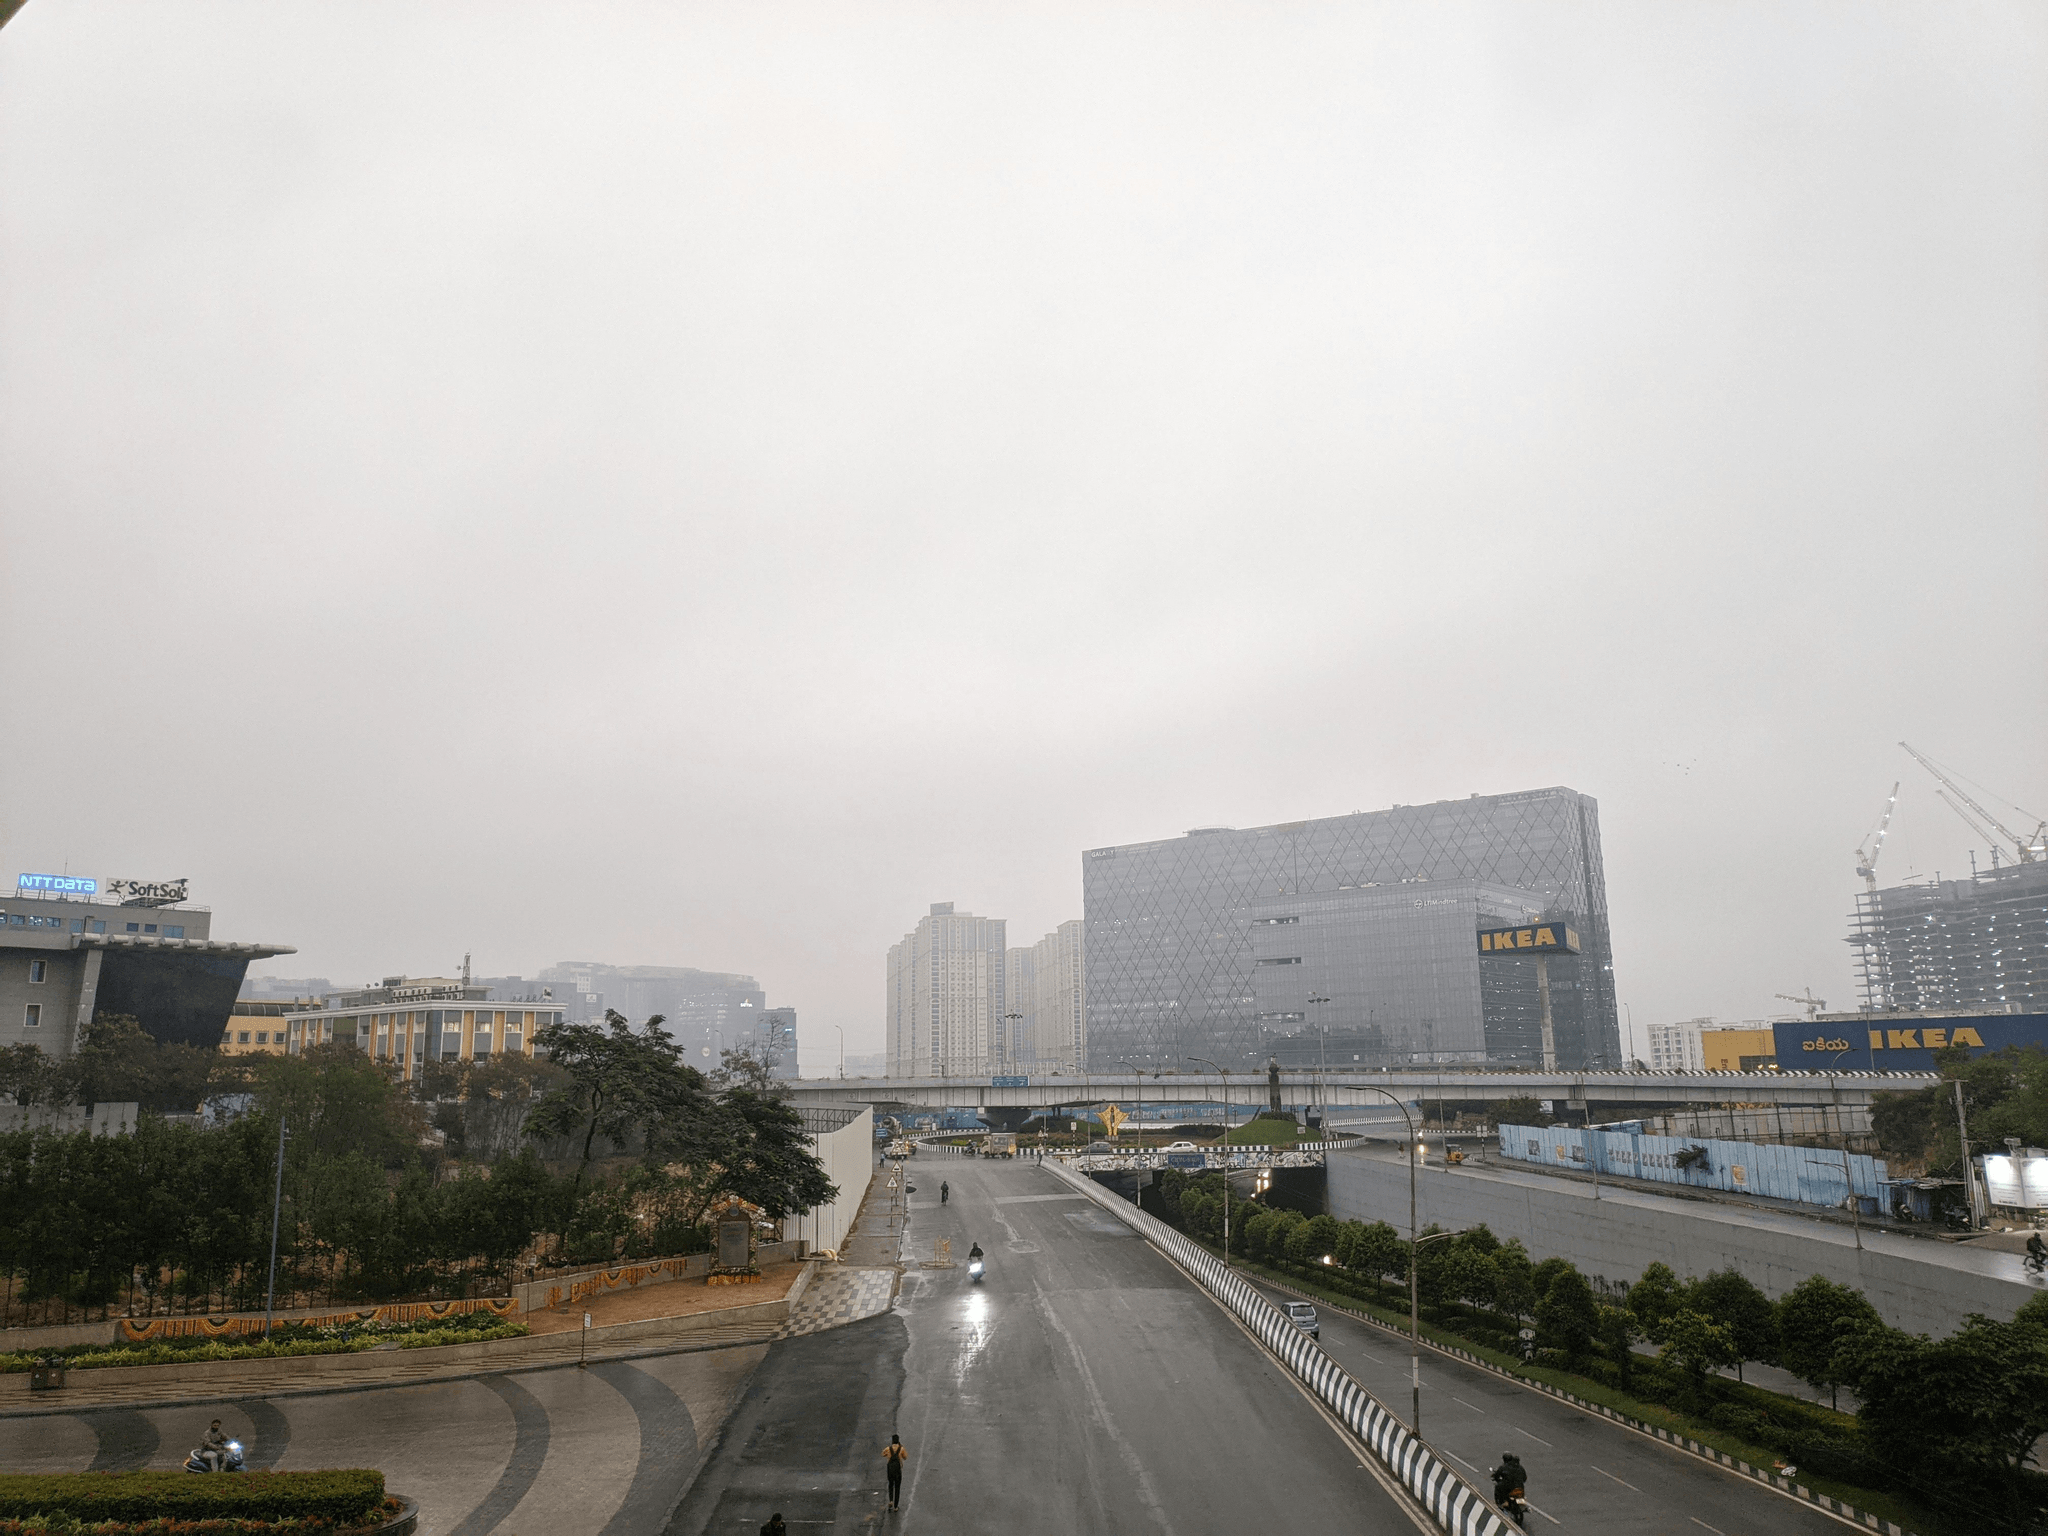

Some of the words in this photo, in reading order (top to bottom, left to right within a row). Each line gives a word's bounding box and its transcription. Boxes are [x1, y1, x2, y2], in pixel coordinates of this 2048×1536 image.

[1091, 849, 1115, 858] GALAY
[20, 875, 53, 888] NTT
[128, 881, 181, 898] SoftSol
[1481, 927, 1557, 951] IKEA
[1802, 1036, 1849, 1051] ఐకియ
[1868, 1027, 1986, 1049] IKEA
